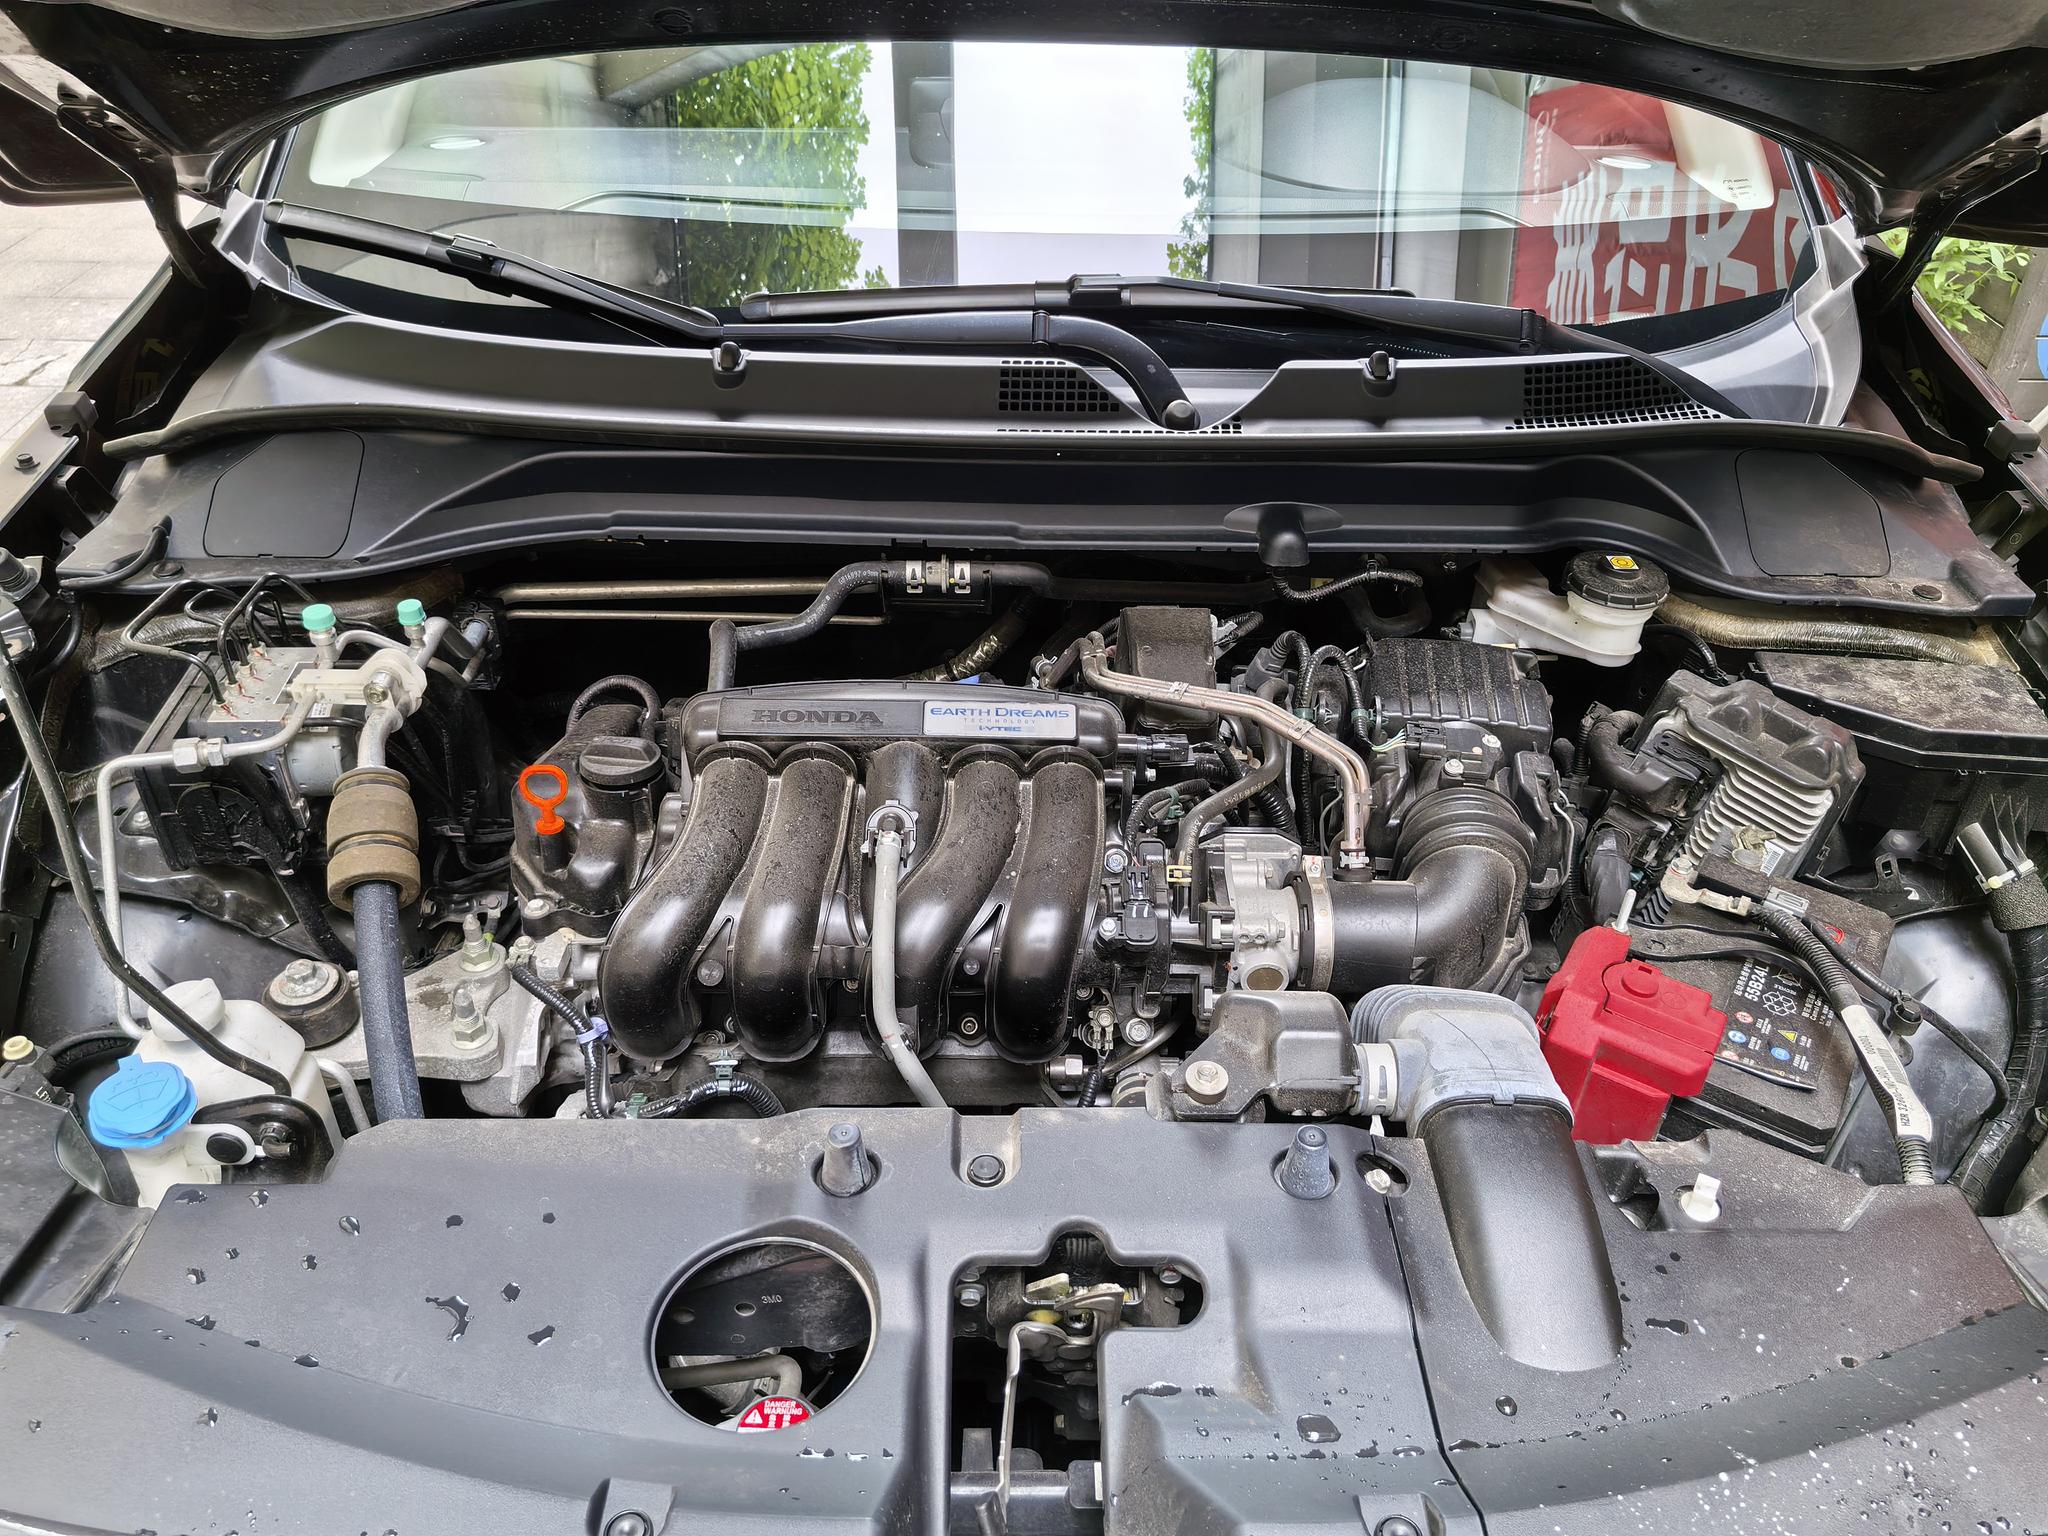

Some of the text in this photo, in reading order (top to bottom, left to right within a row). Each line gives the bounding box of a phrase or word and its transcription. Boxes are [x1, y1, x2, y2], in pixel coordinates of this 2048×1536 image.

[751, 709, 884, 725] HONDA
[929, 707, 1069, 718] EARTH DREAMS
[1744, 962, 1770, 1002] 55B24L
[761, 1295, 783, 1304] 3M0
[764, 1400, 796, 1408] DANGER
[763, 1407, 803, 1415] WARNUNG
